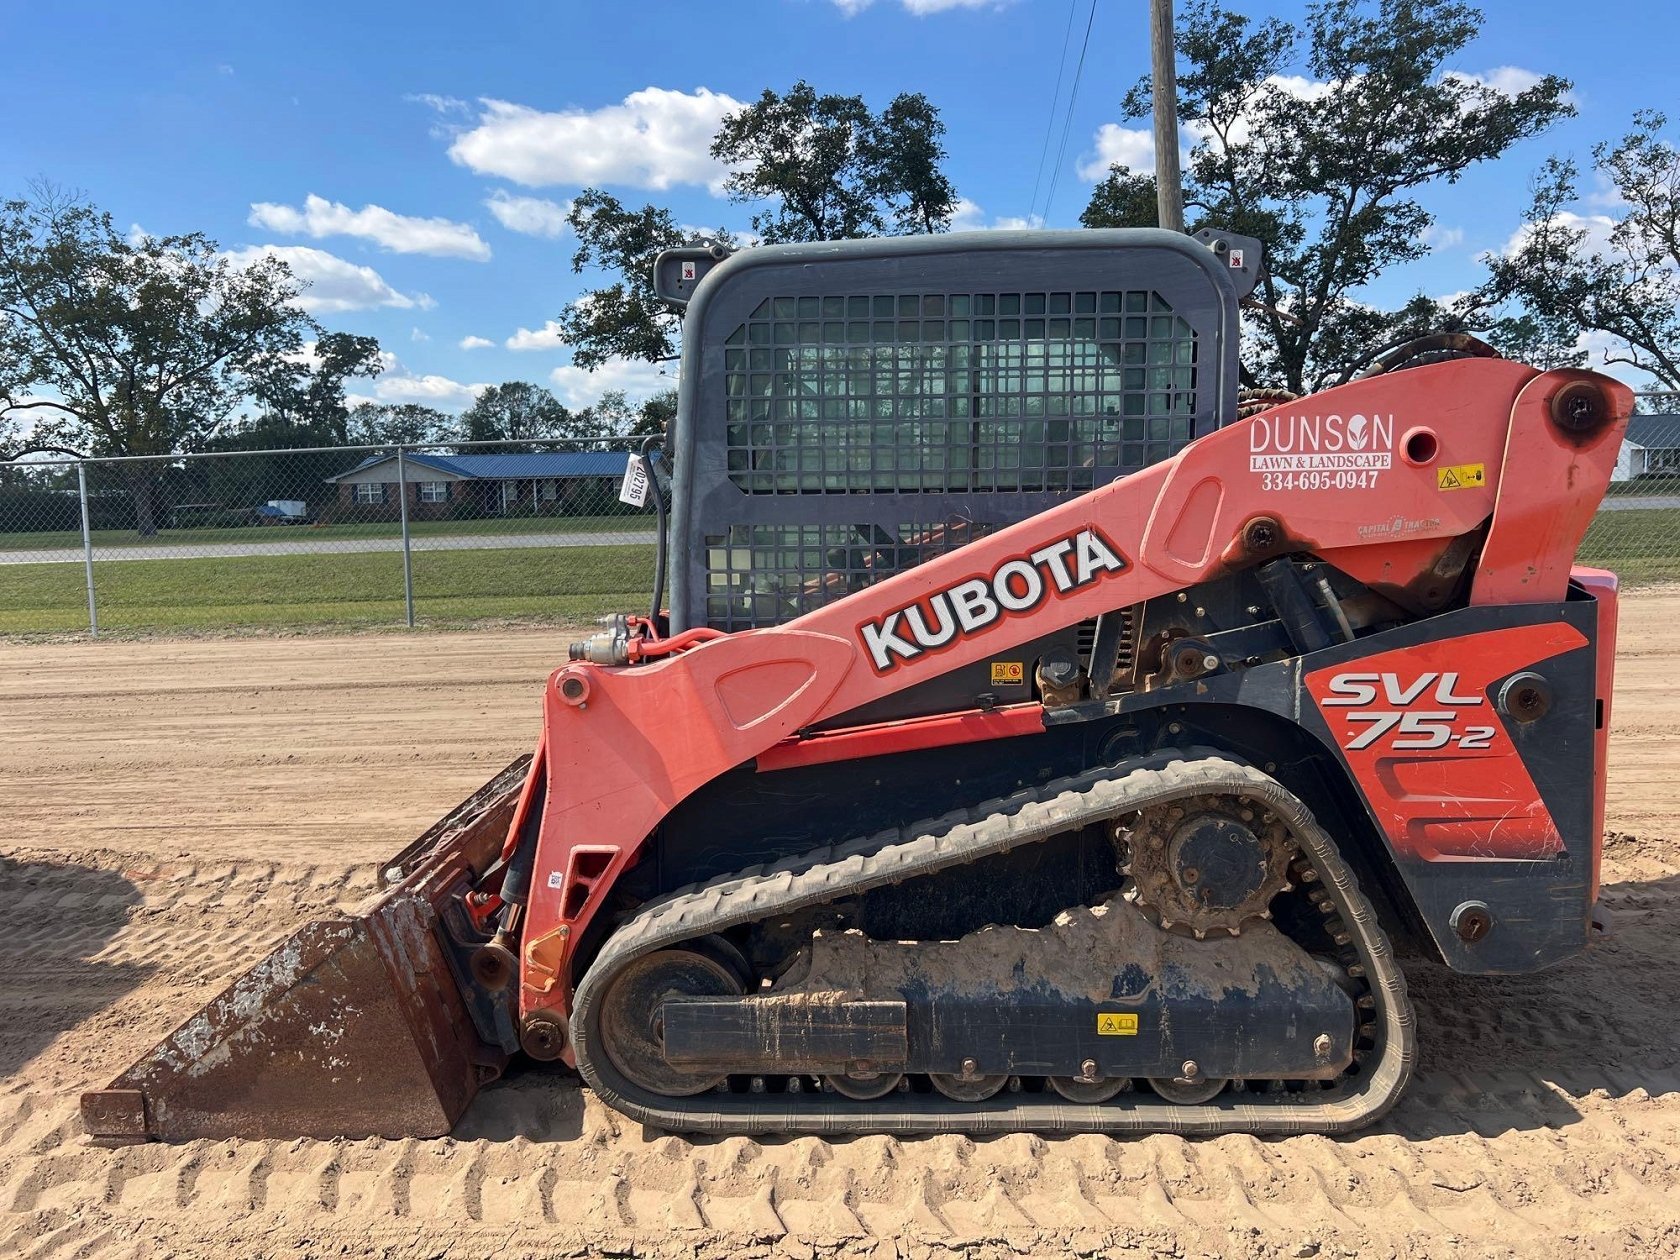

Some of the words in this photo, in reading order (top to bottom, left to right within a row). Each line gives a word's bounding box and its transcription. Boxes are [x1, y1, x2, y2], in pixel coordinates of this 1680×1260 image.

[1252, 455, 1294, 470] LAWN
[1296, 455, 1306, 469] &
[1308, 454, 1390, 469] LANDSCAPE
[1262, 470, 1378, 490] 334-695-0947
[861, 530, 1124, 671] KUBOTA
[1321, 673, 1484, 706] SVL
[1344, 711, 1496, 749] 75-2
